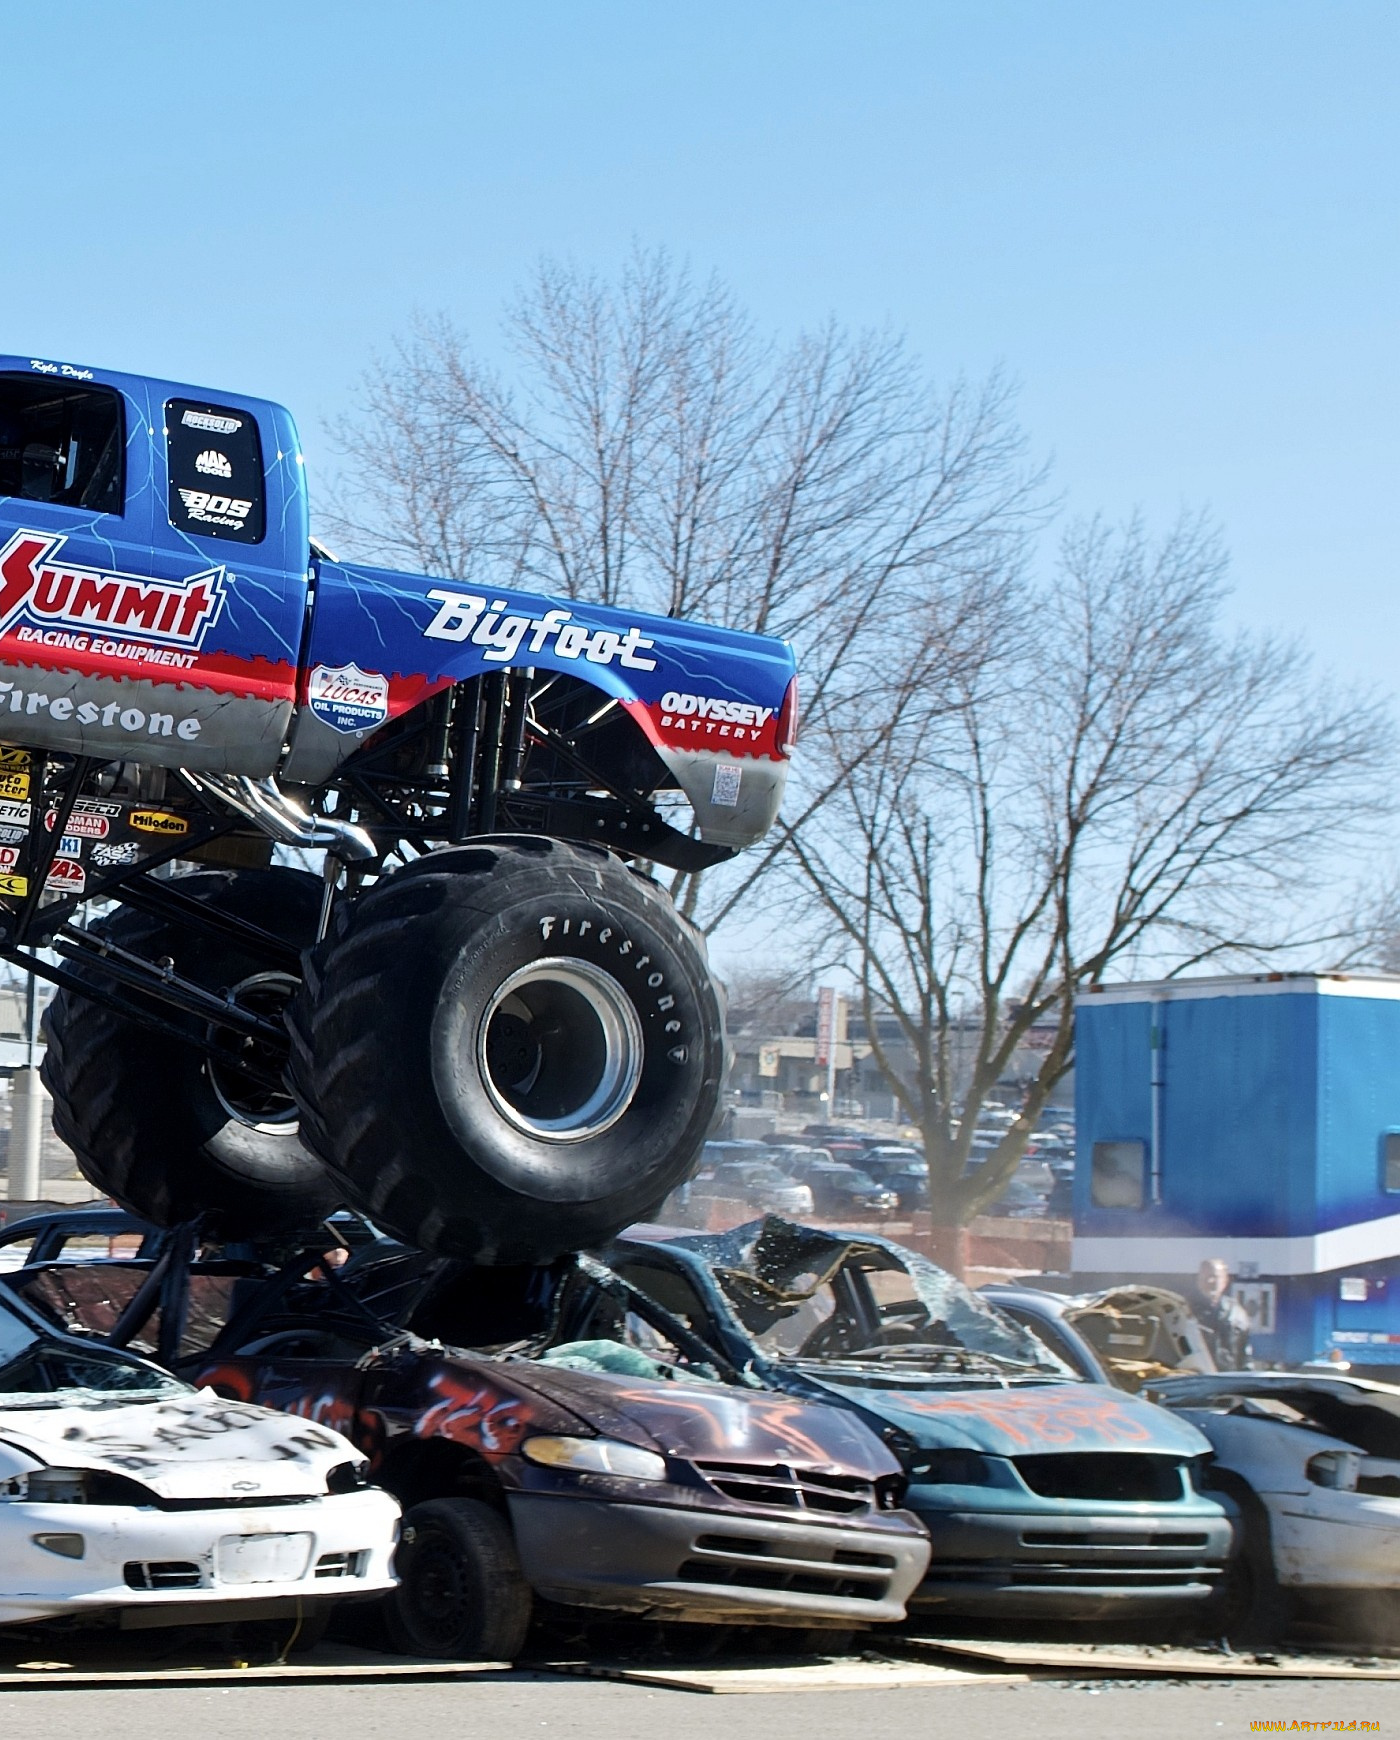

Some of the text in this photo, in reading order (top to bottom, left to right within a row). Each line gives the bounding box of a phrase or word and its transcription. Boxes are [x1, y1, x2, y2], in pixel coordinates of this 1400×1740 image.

[30, 360, 93, 380] Kyle Doyle
[196, 450, 232, 471] MAC
[196, 465, 232, 478] TOOLS
[188, 508, 245, 530] Racing
[423, 589, 657, 671] Bigfoot
[17, 627, 198, 669] RACING EQUIPMENT
[319, 685, 381, 705] LUCAS
[313, 702, 382, 719] OIL PRODUCTS
[661, 692, 772, 727] ODYSSEY
[337, 717, 356, 726] INC.
[661, 716, 761, 741] BATTERY
[133, 815, 185, 831] Milodon
[539, 915, 681, 1032] Firestone
